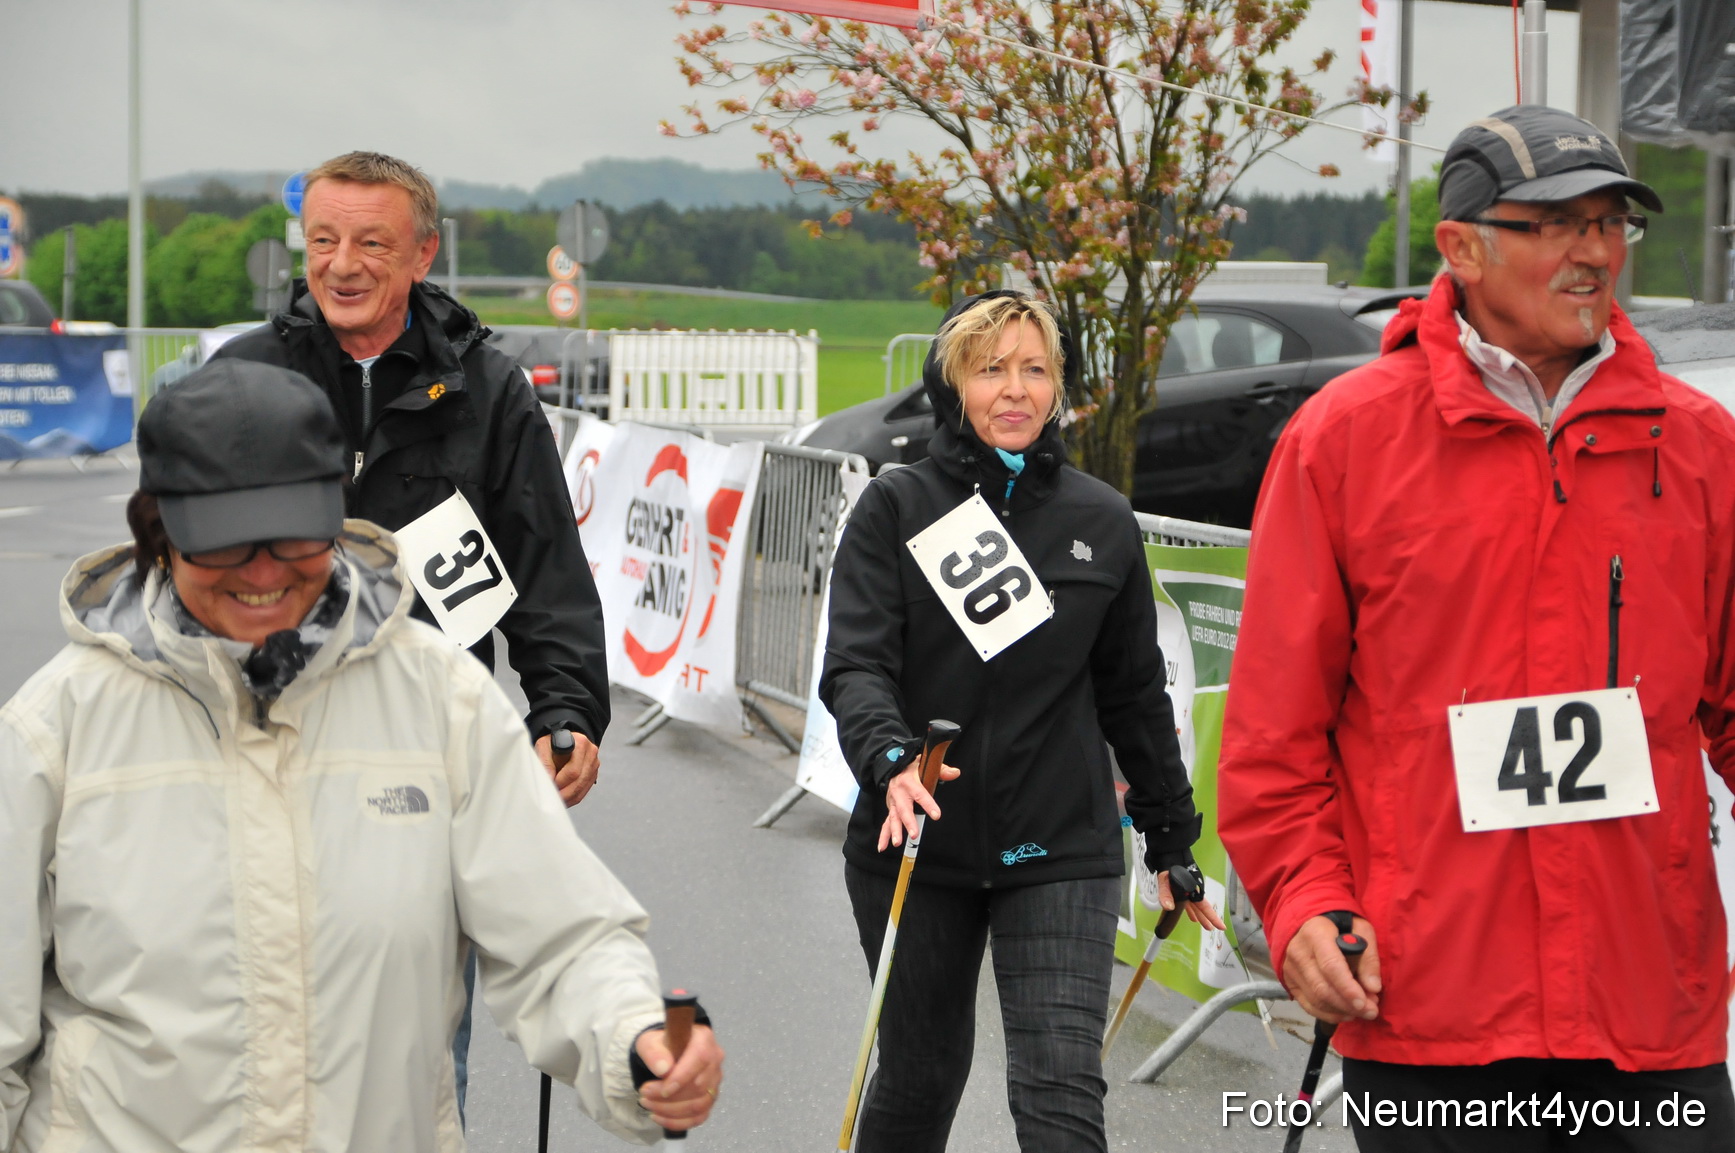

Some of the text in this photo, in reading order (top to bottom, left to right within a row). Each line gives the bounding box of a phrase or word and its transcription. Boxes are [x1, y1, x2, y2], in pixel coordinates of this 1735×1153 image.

[423, 529, 503, 613] 37
[940, 530, 1032, 625] 36
[1188, 600, 1206, 619] PROBE
[1206, 604, 1225, 625] FAHREN
[1224, 608, 1236, 627] UND
[1192, 624, 1205, 643] UEFA
[1204, 627, 1217, 646] EURO
[1217, 631, 1230, 650] 2012
[1497, 700, 1607, 807] 42
[367, 796, 408, 807] NORTH
[383, 786, 406, 798] THE
[379, 804, 409, 815] FACE
